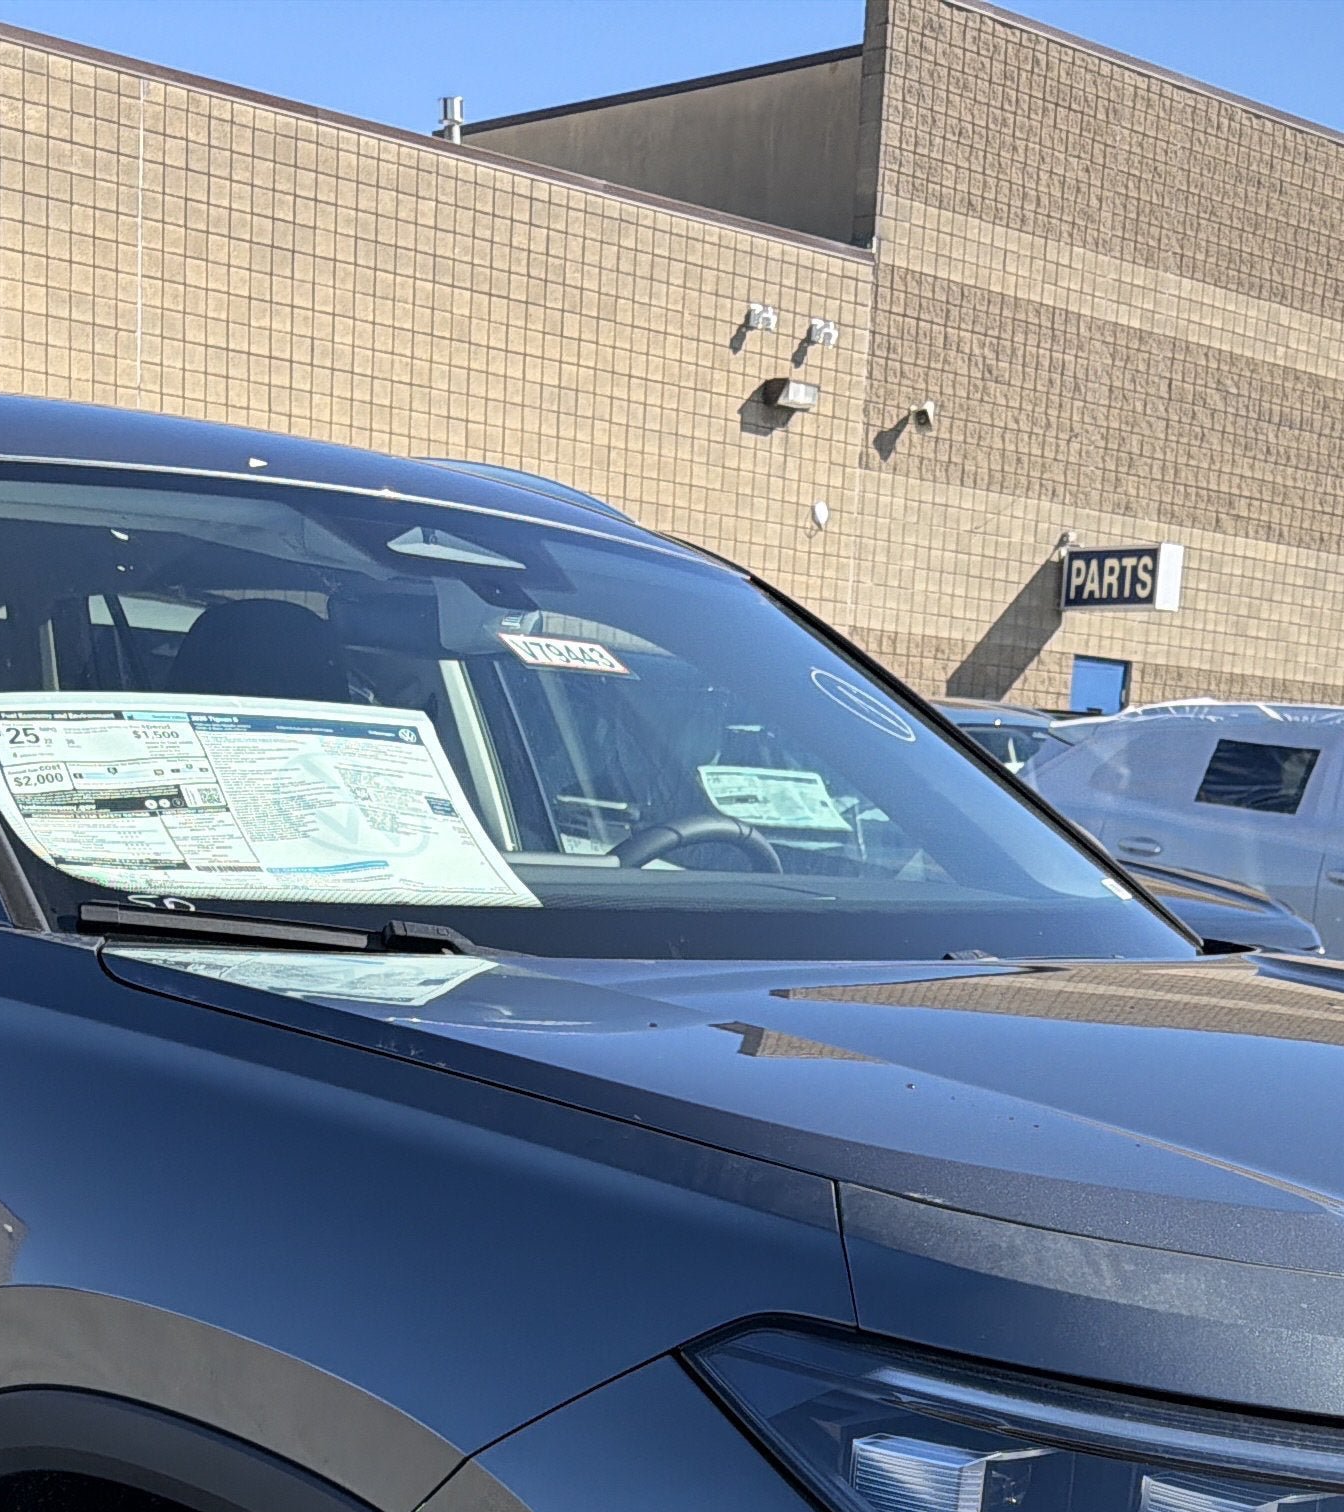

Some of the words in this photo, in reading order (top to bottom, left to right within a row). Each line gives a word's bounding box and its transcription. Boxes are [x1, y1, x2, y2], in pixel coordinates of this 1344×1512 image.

[1069, 555, 1154, 600] PARTS
[508, 639, 615, 669] V79443
[6, 727, 40, 745] 25
[132, 730, 180, 740] $1,500
[14, 772, 63, 787] $2,000
